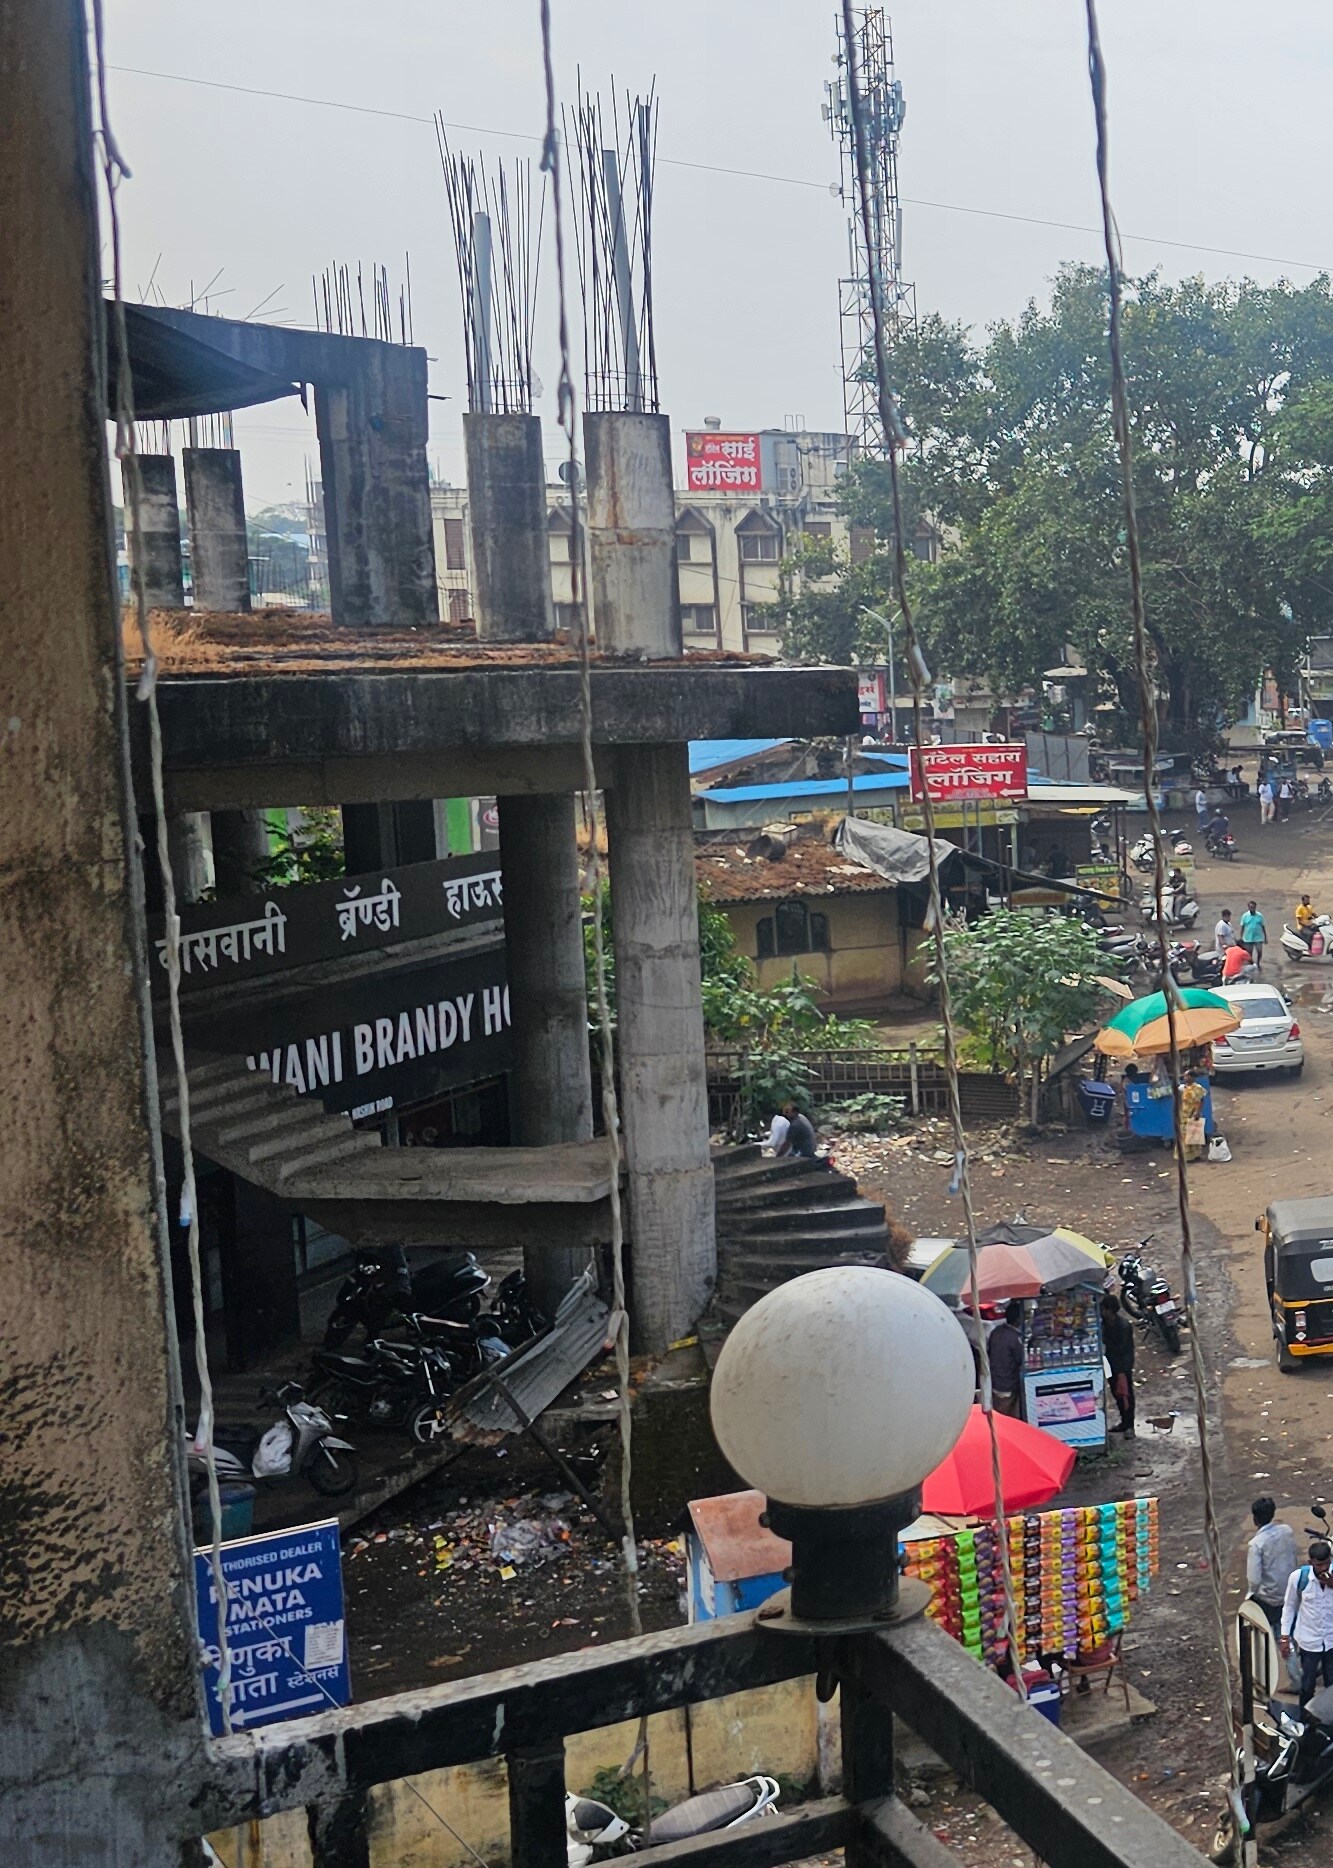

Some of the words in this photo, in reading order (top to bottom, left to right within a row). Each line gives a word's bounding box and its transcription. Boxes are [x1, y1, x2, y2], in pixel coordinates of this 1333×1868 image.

[721, 437, 755, 461] साई
[690, 460, 757, 485] लॉजिंग
[972, 752, 1021, 765] सहारा
[925, 766, 1013, 787] लॉजिंग
[354, 994, 475, 1075] BRANDY
[483, 983, 511, 1036] H
[280, 1542, 323, 1561] DEALER
[230, 1589, 306, 1622] MATA
[225, 1607, 313, 1637] STATIONERS
